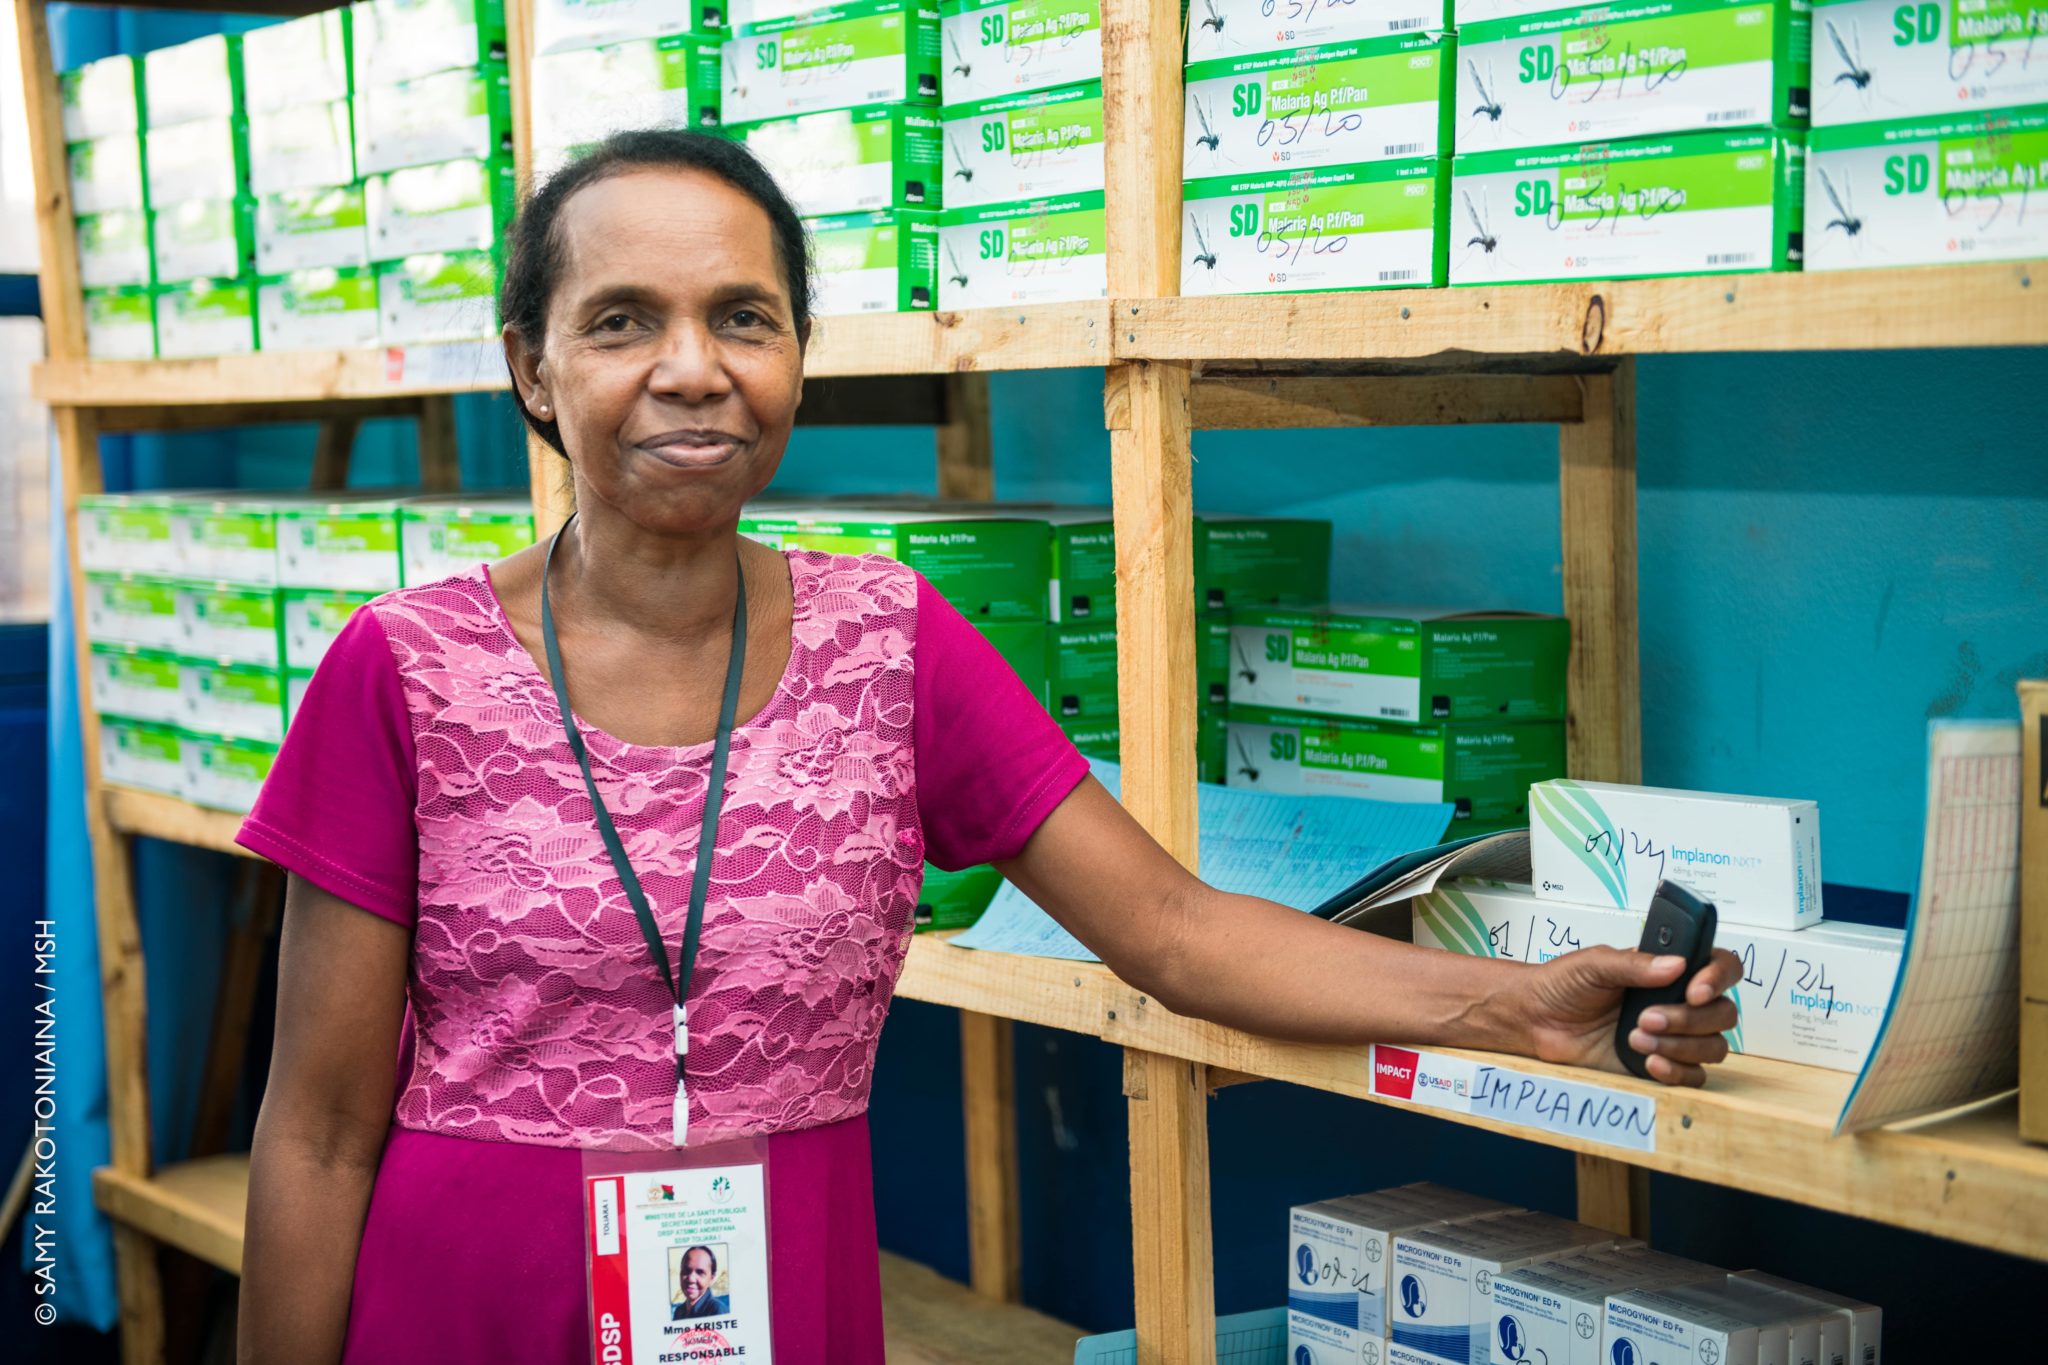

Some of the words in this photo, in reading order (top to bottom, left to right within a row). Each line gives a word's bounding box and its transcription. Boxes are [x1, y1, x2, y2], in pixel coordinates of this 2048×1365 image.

[981, 14, 1004, 46] SD
[1012, 22, 1044, 39] Malaria
[1894, 2, 1941, 46] SD
[1958, 12, 2022, 38] Malaria
[756, 42, 776, 70] SD
[1519, 44, 1554, 84] SD
[1567, 55, 1615, 77] Malaria
[1618, 50, 1636, 73] Ag
[1232, 82, 1262, 118] SD
[1271, 92, 1310, 112] Malaria
[1313, 90, 1328, 108] Ag
[1257, 104, 1362, 147] 05/20
[982, 122, 1004, 152] SD
[1012, 130, 1045, 148] Malaria
[1280, 152, 1291, 161] SD
[1884, 154, 1929, 196] SD
[1946, 166, 2008, 188] Malaria
[1514, 180, 1552, 217] SD
[1564, 192, 1614, 214] Malaria
[1618, 188, 1636, 212] Ag
[1230, 204, 1259, 237] SD
[1268, 216, 1306, 233] Malaria
[1310, 214, 1324, 232] Ag
[980, 230, 1004, 260] SD
[1012, 240, 1044, 256] Malaria
[1257, 222, 1348, 266] 05/20
[910, 534, 938, 544] Malaria
[940, 534, 950, 545] Ag
[1266, 634, 1288, 662] SD
[1433, 632, 1460, 642] Malaria
[1462, 632, 1472, 644] Ag
[1296, 650, 1326, 665] Malaria
[1328, 652, 1340, 668] Ag
[1270, 732, 1296, 761] SD
[1456, 736, 1482, 745] Malaria
[1483, 736, 1492, 746] Ag
[1305, 750, 1339, 765] Malaria
[1342, 752, 1353, 768] Ag
[1672, 845, 1730, 866] Implanon
[1790, 989, 1853, 1013] Implanon
[1376, 1062, 1412, 1080] IMPACT
[1428, 1076, 1452, 1088] USAID
[1471, 1067, 1656, 1137] IMPLANON
[602, 1204, 610, 1236] TOLIARA
[645, 1212, 676, 1220] MINISTERE
[688, 1210, 696, 1218] LA
[718, 1206, 747, 1215] PUBLIQUE
[661, 1220, 702, 1228] SECRETARIAT
[1336, 1226, 1345, 1234] ED
[1346, 1228, 1353, 1236] Fe
[1444, 1256, 1452, 1264] ED
[1454, 1258, 1462, 1268] Fe
[1542, 1296, 1552, 1306] ED
[1553, 1300, 1561, 1310] Fe
[664, 1326, 690, 1336] Mme
[694, 1320, 738, 1332] KRISTE
[1334, 1327, 1342, 1336] ED
[1343, 1330, 1350, 1338] Fe
[1663, 1320, 1674, 1330] ED
[1674, 1324, 1684, 1334] Fe
[600, 1312, 622, 1365] DSP
[659, 1346, 746, 1363] RESPONSABLE
